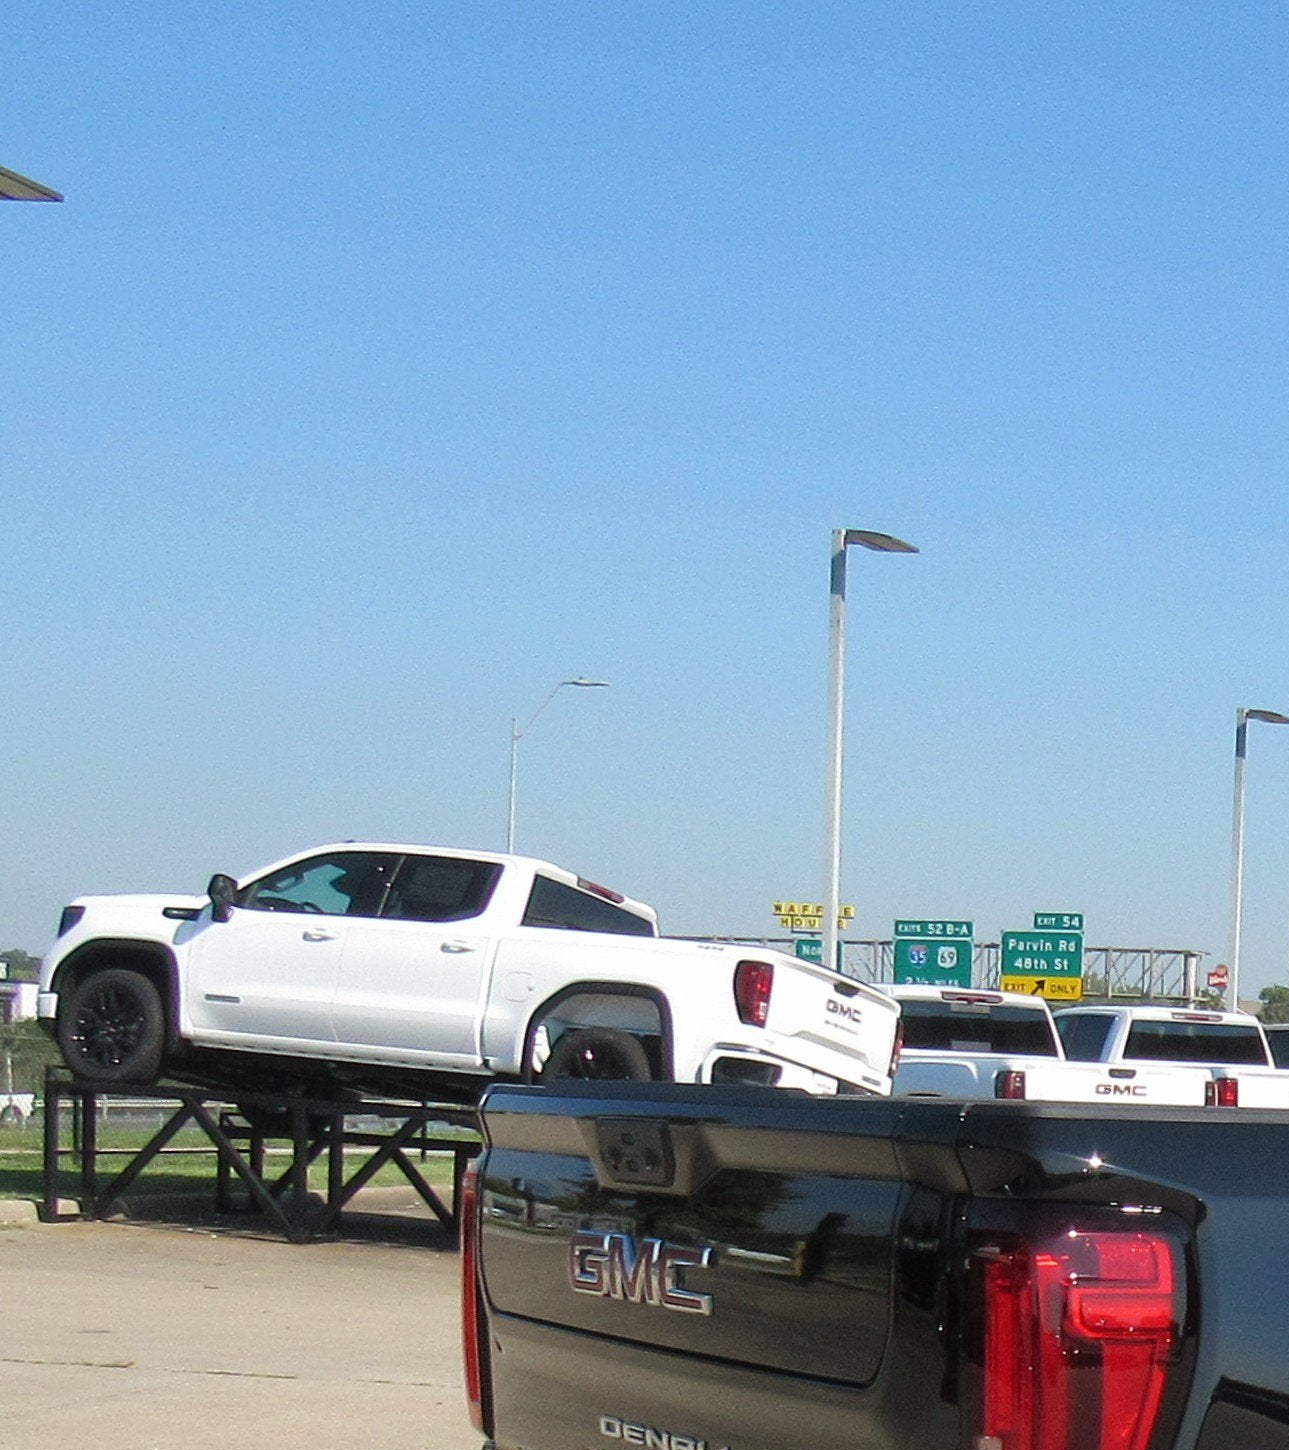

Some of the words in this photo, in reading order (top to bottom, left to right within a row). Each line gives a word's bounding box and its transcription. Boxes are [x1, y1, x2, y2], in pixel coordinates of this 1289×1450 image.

[773, 903, 852, 917] WAFFE
[782, 917, 844, 928] HOUE
[1037, 917, 1056, 927] EXIT
[1063, 916, 1080, 928] 54
[928, 923, 943, 935] 52
[1008, 939, 1053, 952] Parvin
[1058, 940, 1077, 952] Rd
[911, 951, 927, 965] 35
[940, 951, 956, 964] 69
[1014, 957, 1047, 970] 48th
[1054, 958, 1069, 970] St
[1004, 983, 1026, 992] EXIT
[1050, 984, 1077, 994] ONLY
[826, 999, 862, 1023] GMC
[1095, 1084, 1147, 1096] GMC
[569, 1229, 713, 1317] GMC
